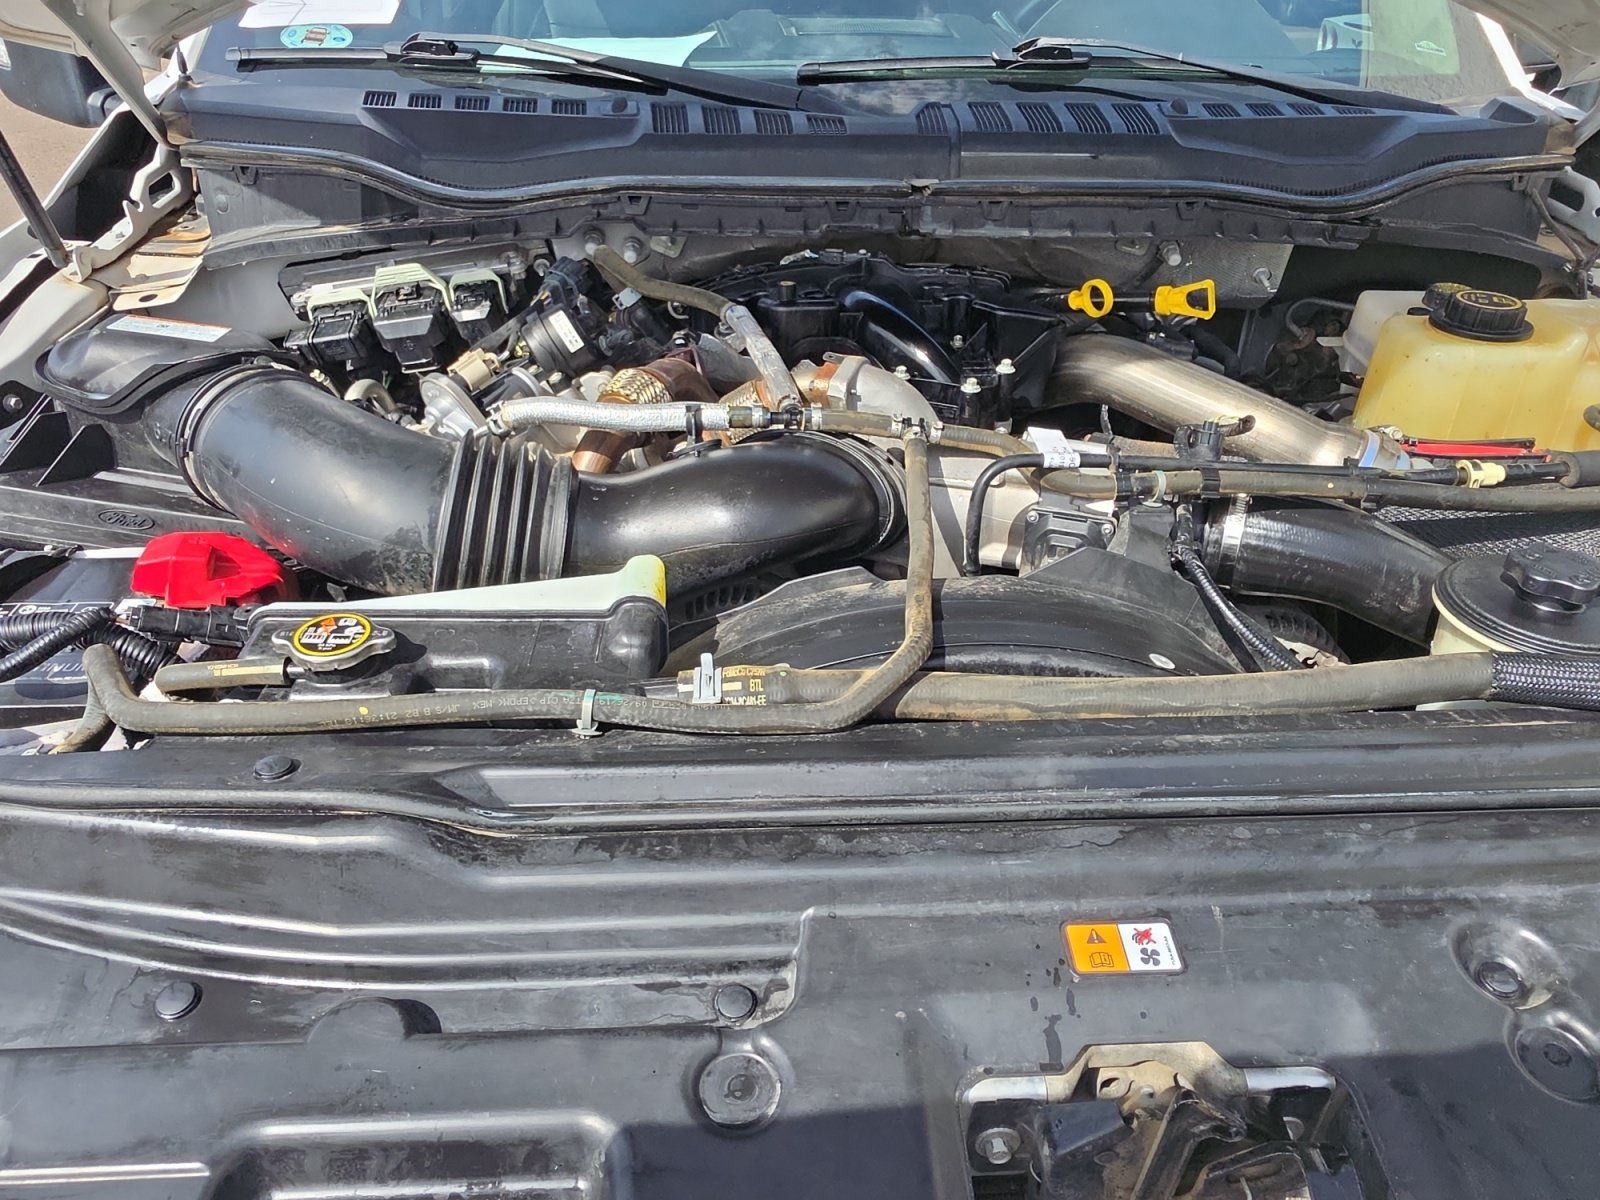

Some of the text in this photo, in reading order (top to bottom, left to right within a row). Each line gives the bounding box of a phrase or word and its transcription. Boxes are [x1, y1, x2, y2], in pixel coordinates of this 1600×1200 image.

[106, 511, 147, 528] Ford
[750, 678, 764, 692] BTL
[472, 699, 493, 710] MEX
